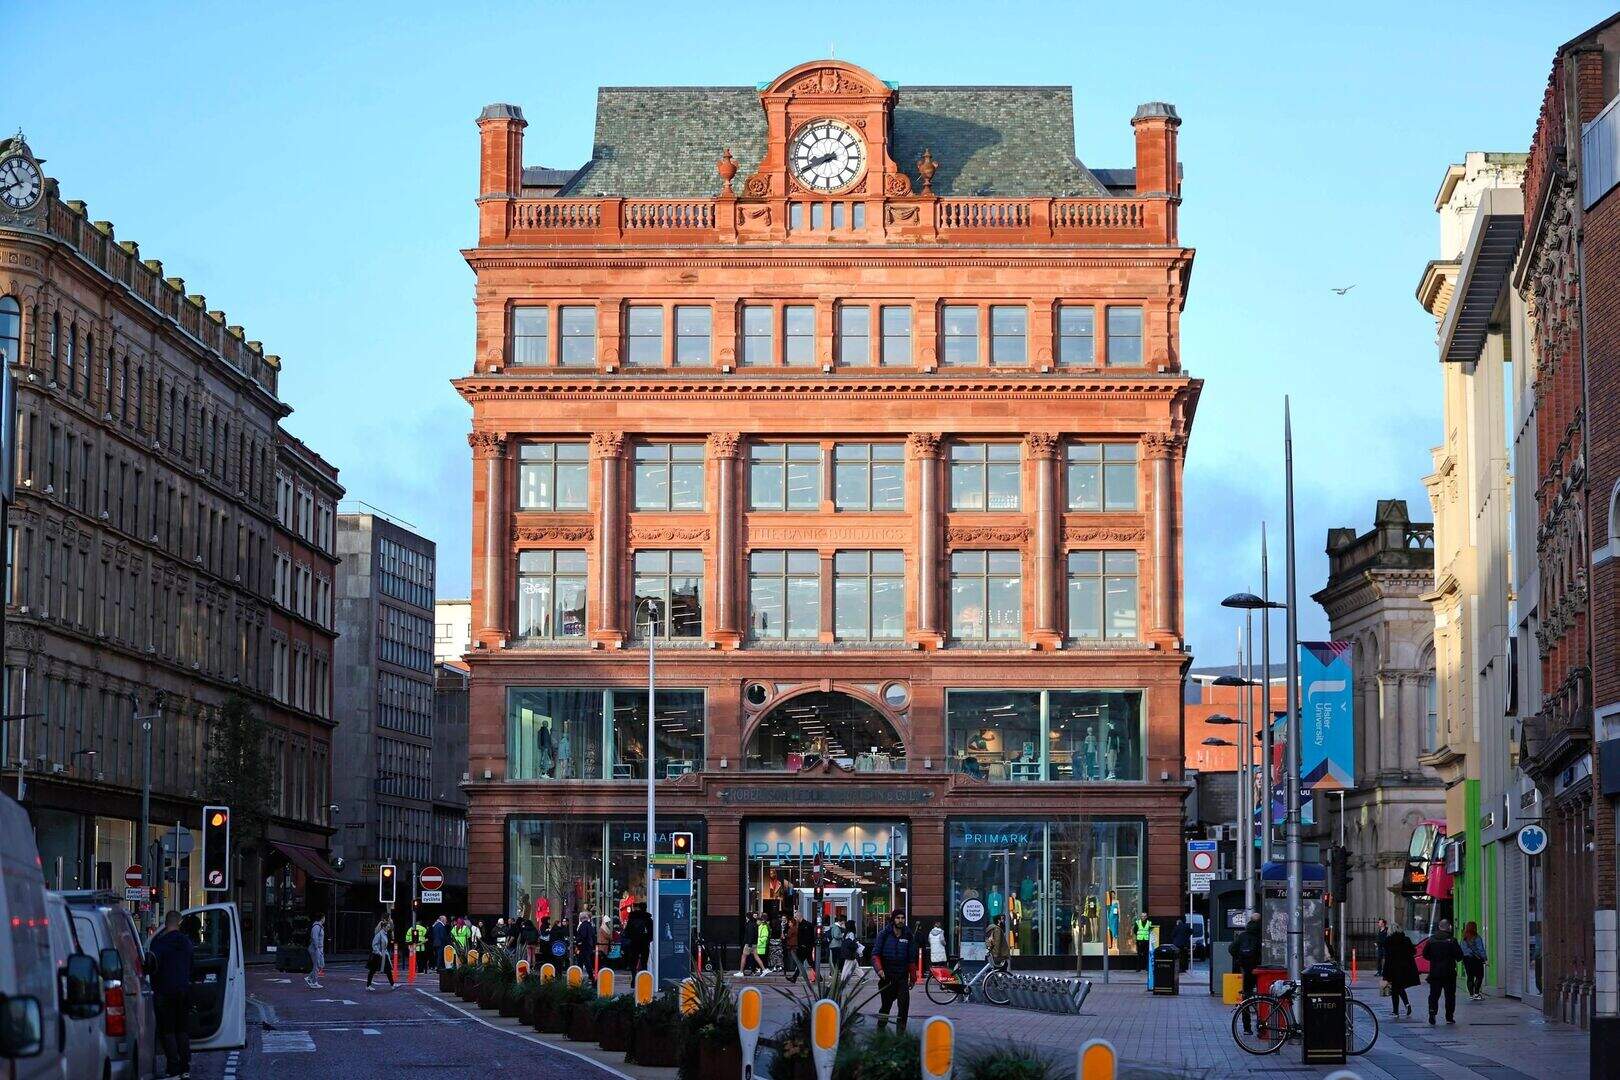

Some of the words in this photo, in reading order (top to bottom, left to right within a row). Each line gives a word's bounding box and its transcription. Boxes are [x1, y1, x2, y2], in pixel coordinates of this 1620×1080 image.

[1323, 702, 1332, 729] Ulster
[1314, 702, 1323, 746] University
[623, 832, 674, 842] PRIAR
[965, 833, 1028, 843] PRIMARK
[1277, 889, 1311, 897] Telne
